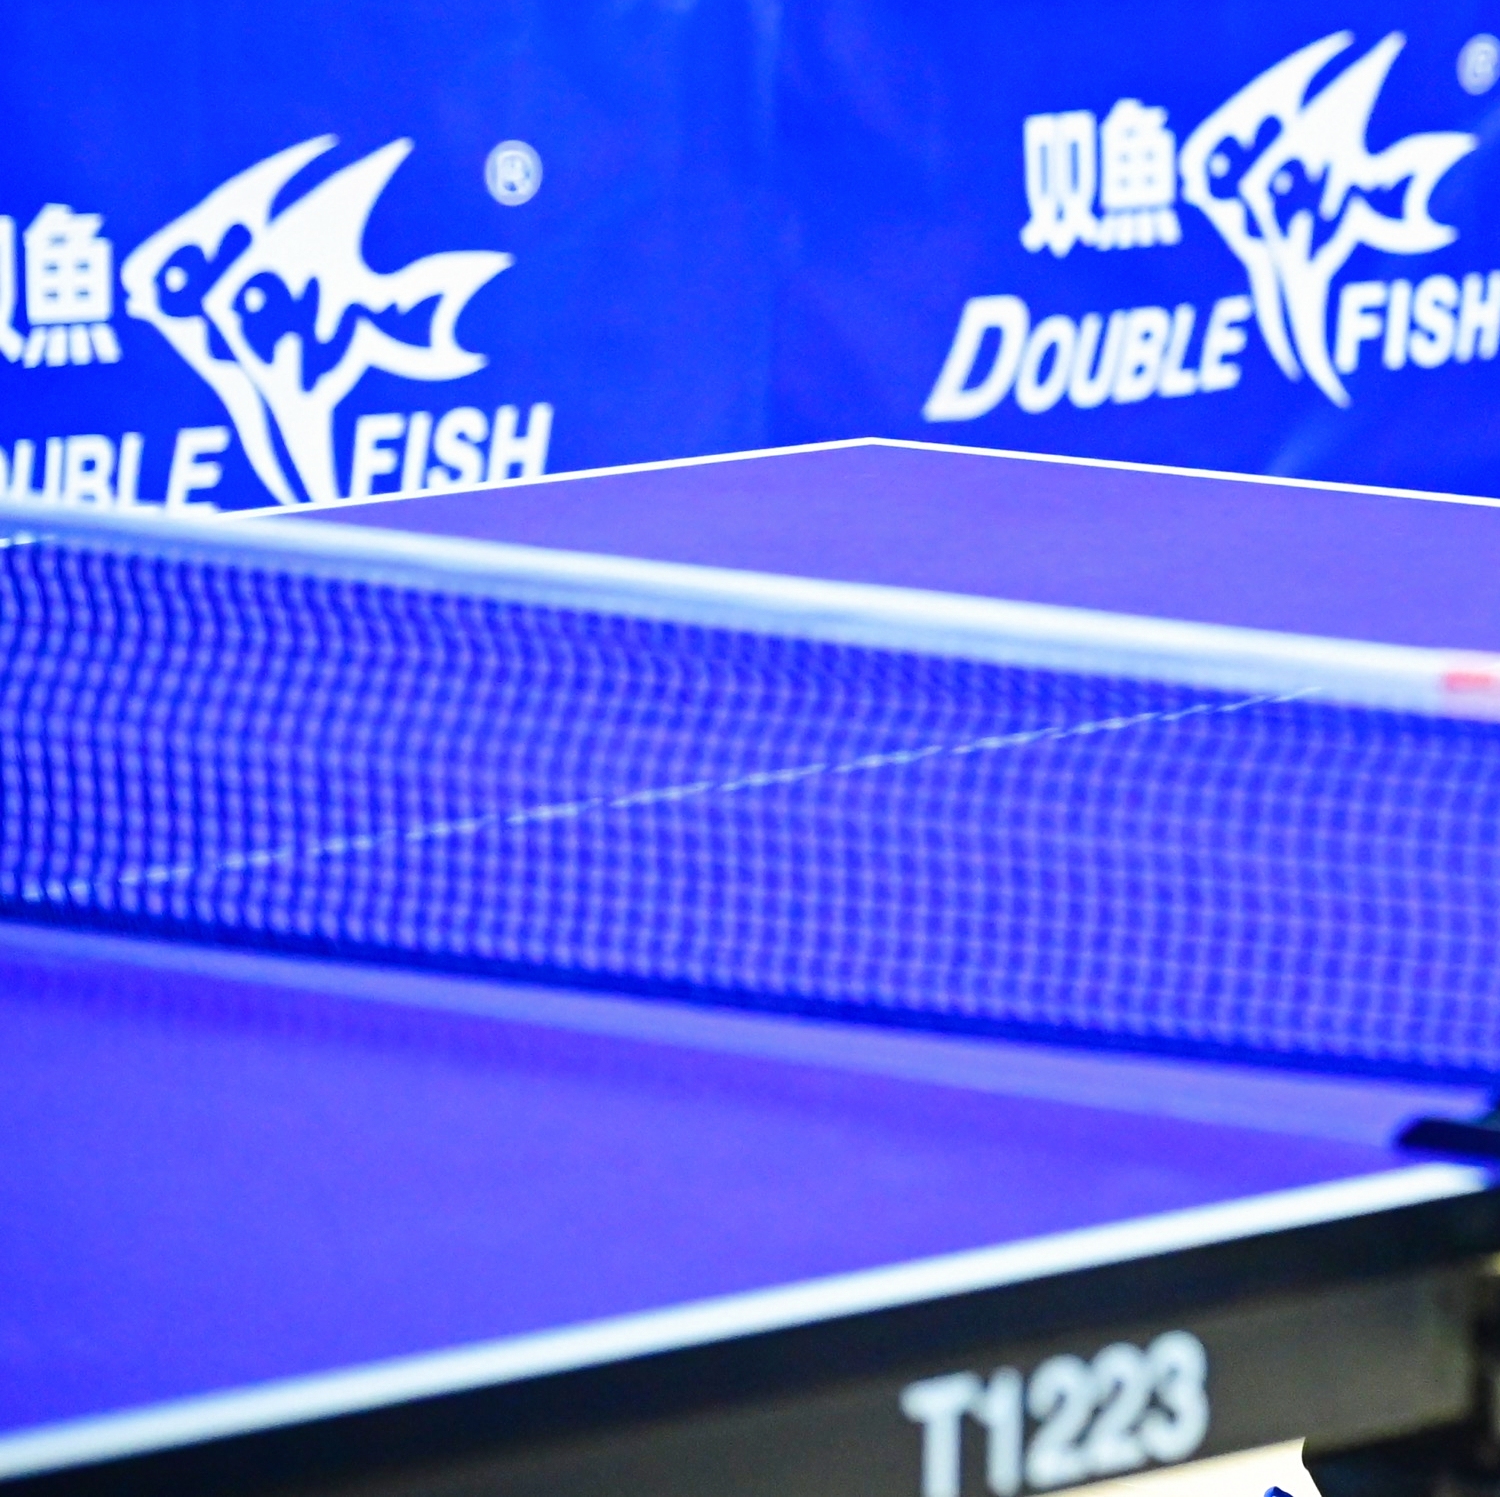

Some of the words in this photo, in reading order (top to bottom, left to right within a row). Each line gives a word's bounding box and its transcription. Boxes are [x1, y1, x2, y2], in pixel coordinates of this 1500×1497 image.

[924, 293, 1253, 422] DOUBLE
[0, 425, 231, 517] UBLE
[351, 402, 554, 500] FISH
[900, 1329, 1210, 1497] T1223
